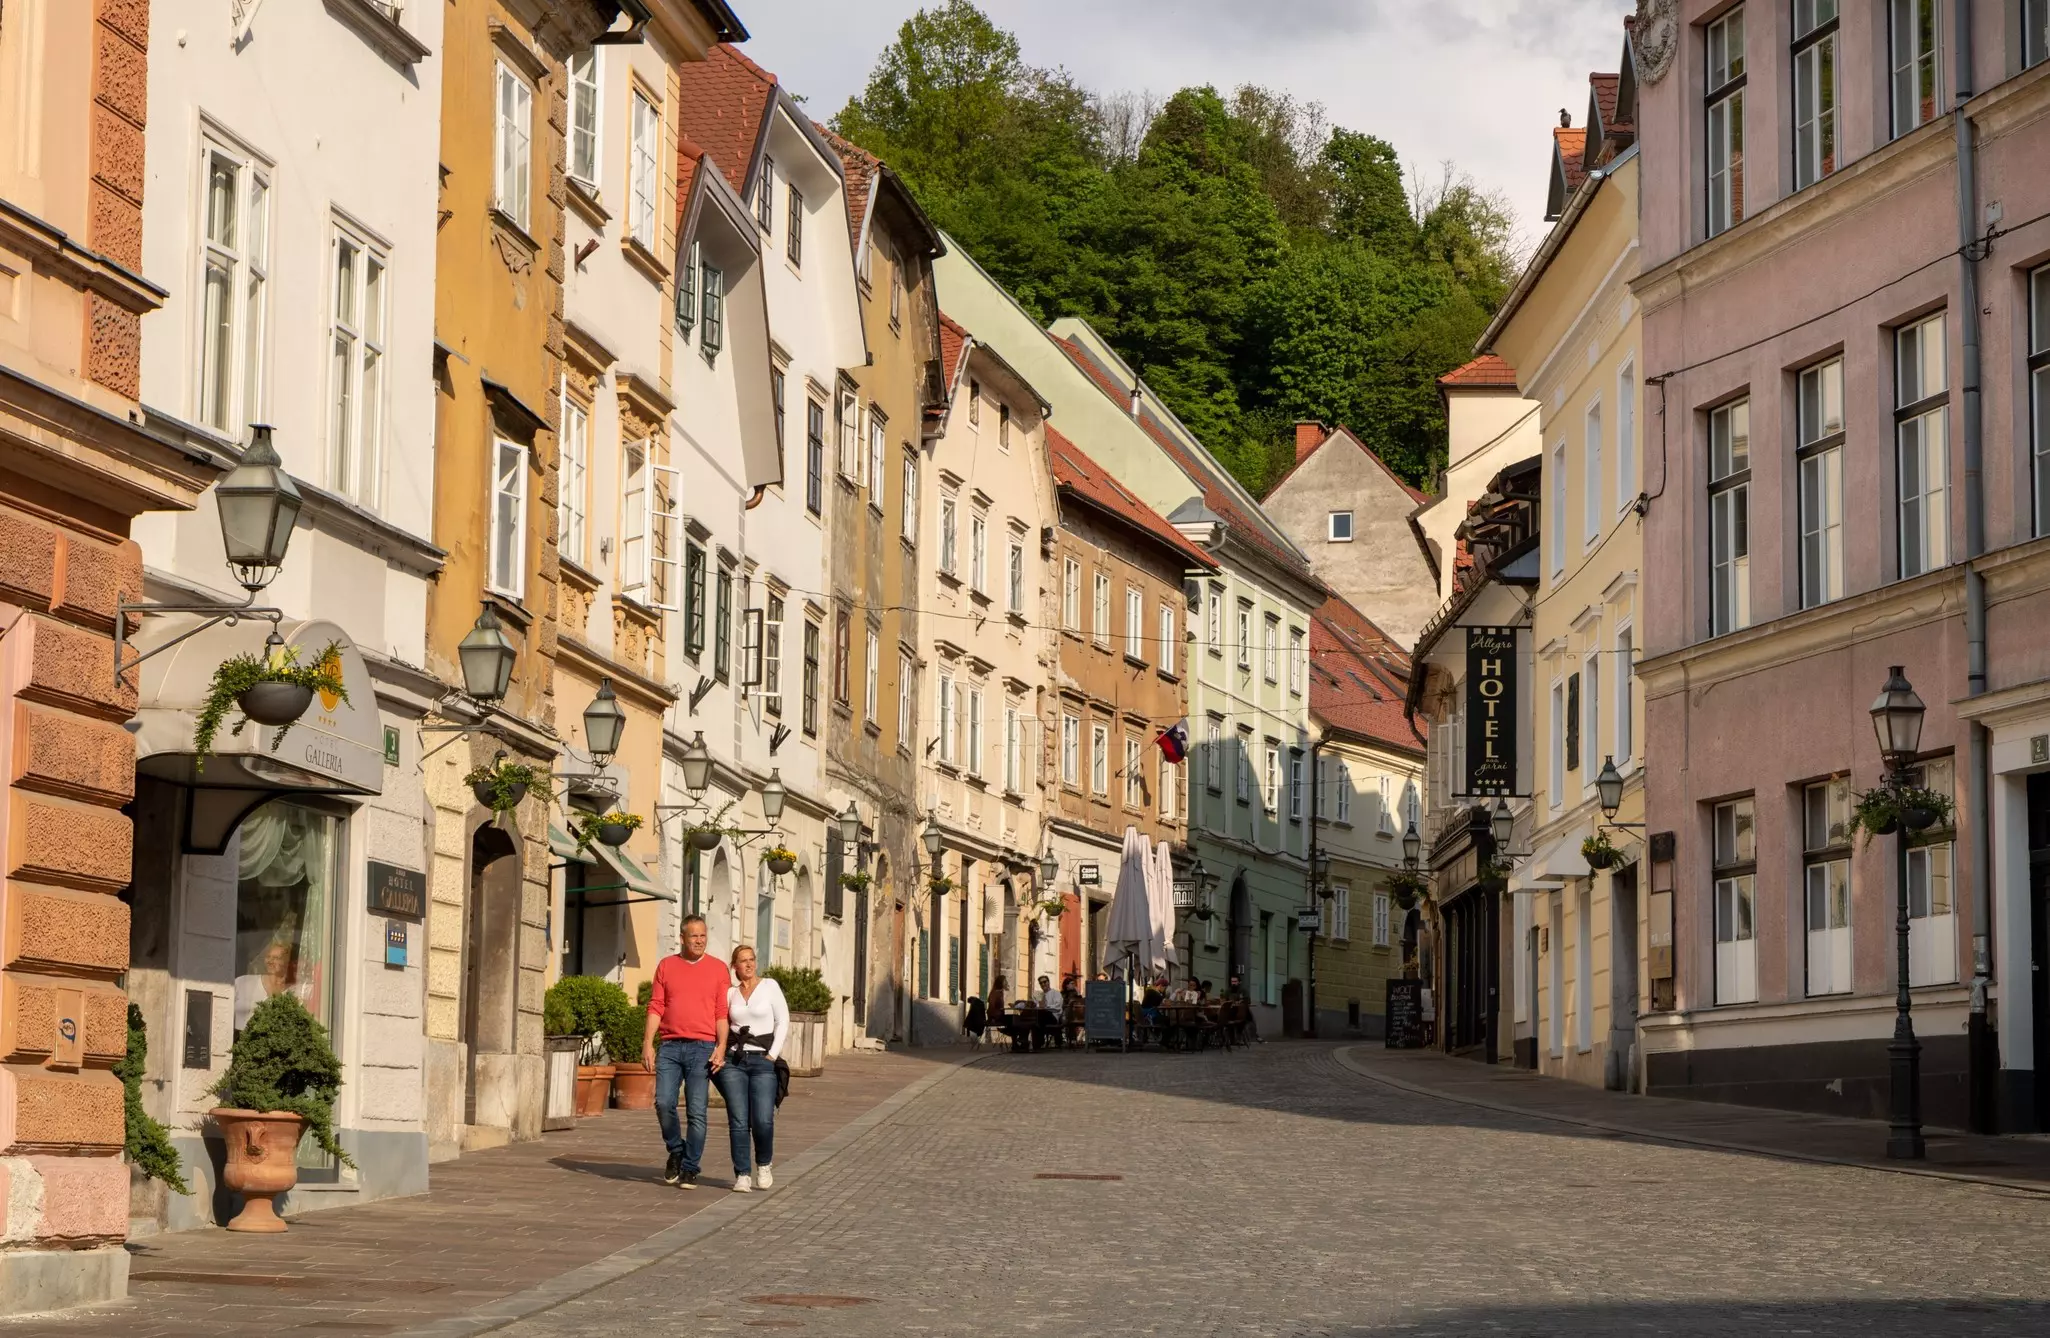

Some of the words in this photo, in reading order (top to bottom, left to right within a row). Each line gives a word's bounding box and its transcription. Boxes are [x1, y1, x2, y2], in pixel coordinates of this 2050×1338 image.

[1469, 635, 1512, 654] Allegro
[1480, 659, 1504, 758] HOTEL
[391, 733, 396, 751] 3
[2036, 740, 2041, 753] 2
[305, 744, 342, 774] GALLERIA
[1474, 762, 1507, 776] garni
[388, 875, 414, 891] HOTEL
[381, 886, 420, 915] GALLERIA
[1173, 891, 1193, 905] MAK
